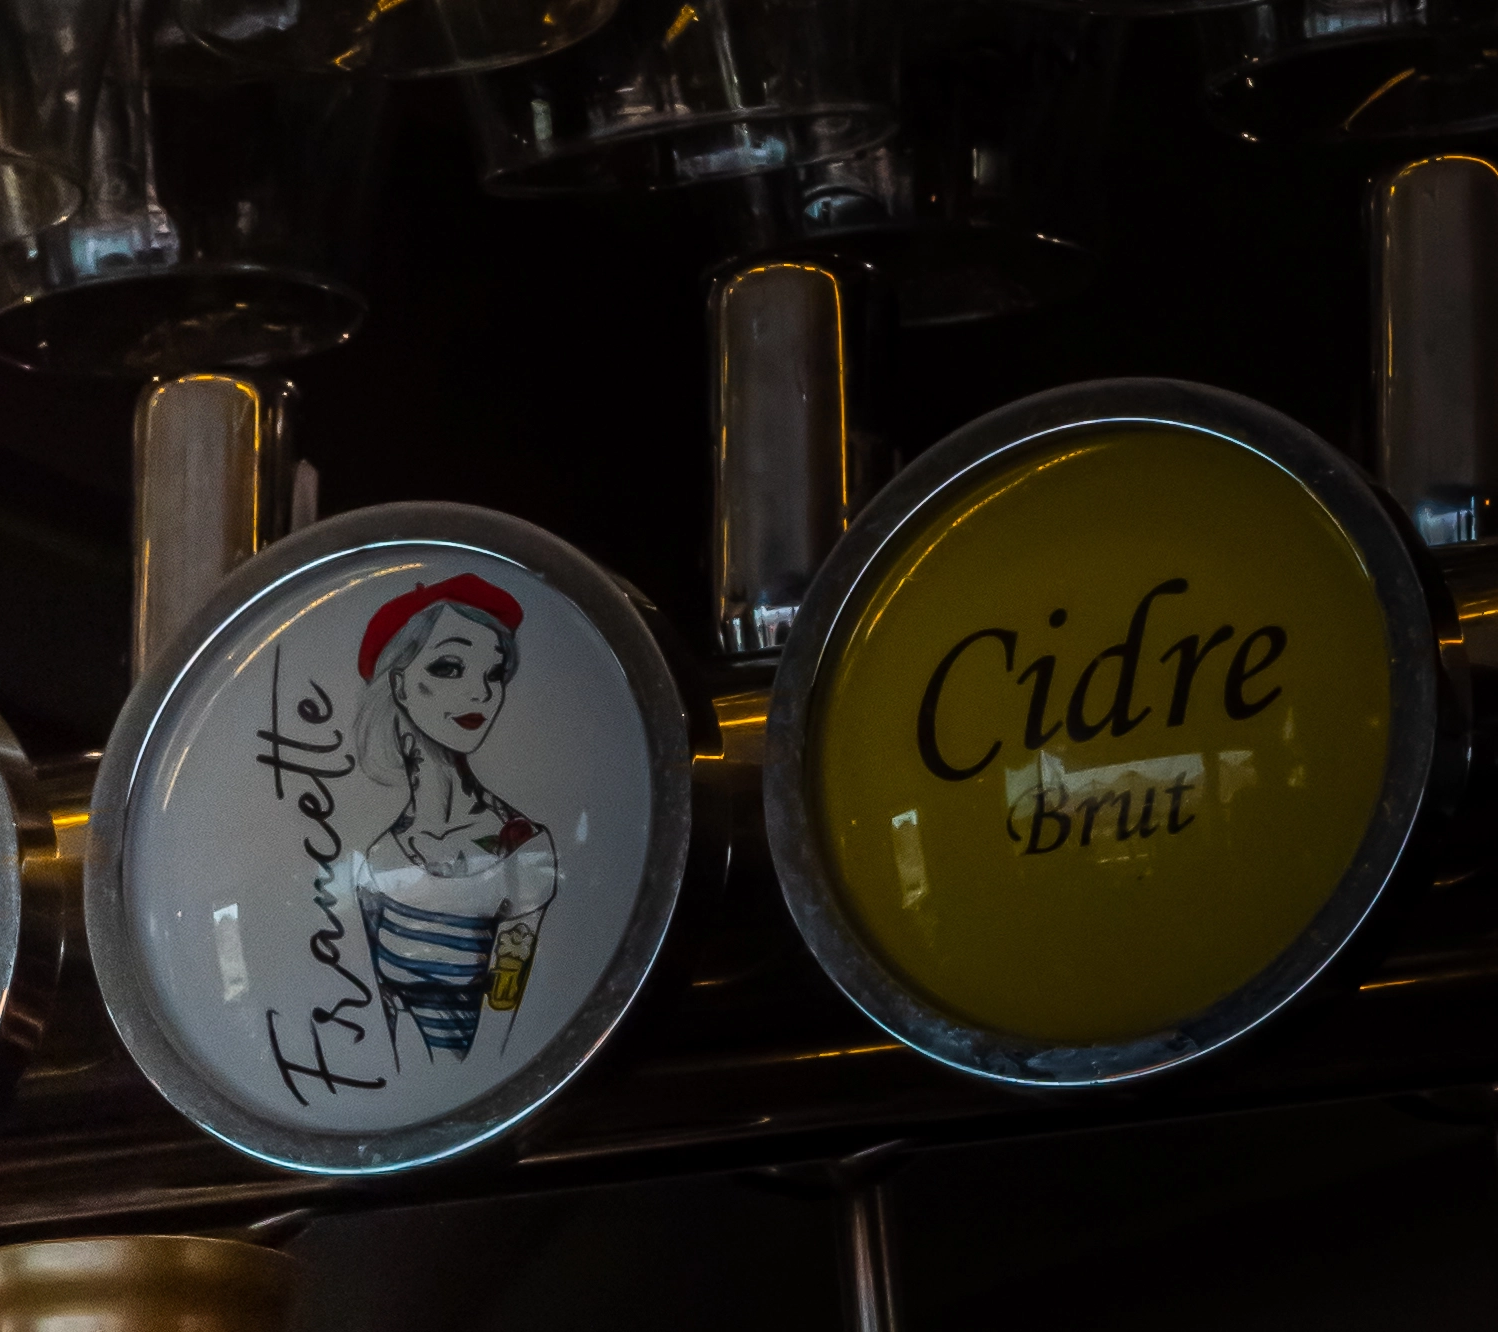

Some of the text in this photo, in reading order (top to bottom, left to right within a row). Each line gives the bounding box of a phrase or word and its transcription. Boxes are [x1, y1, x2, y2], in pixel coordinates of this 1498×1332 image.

[916, 577, 1289, 784] Cidre
[256, 643, 388, 1108] Francette
[1005, 770, 1196, 856] Brut
